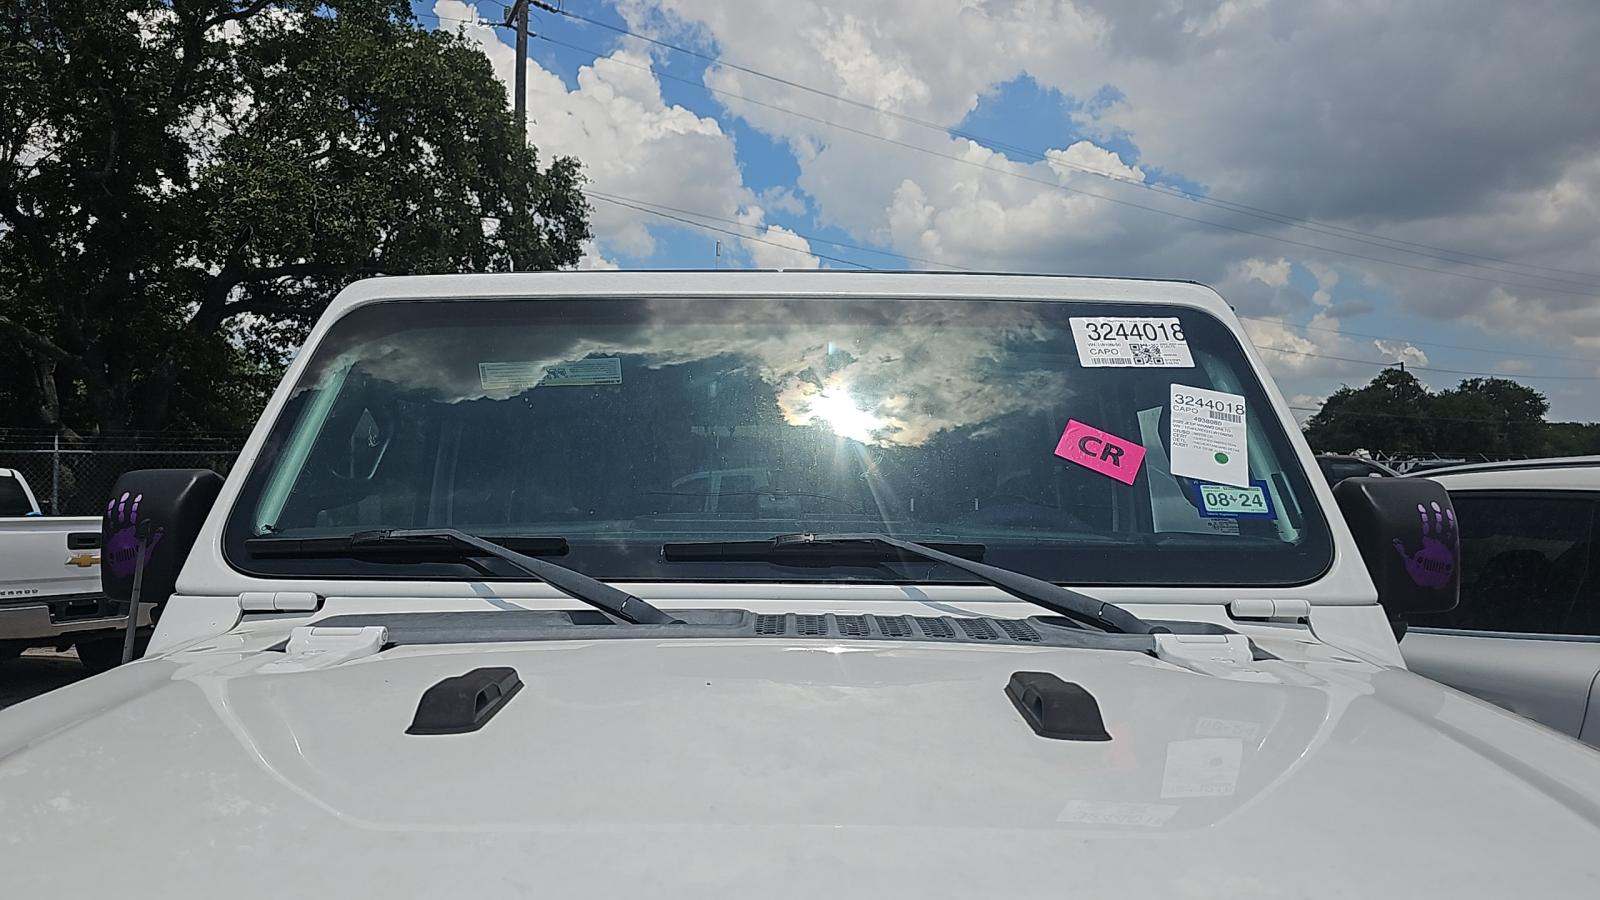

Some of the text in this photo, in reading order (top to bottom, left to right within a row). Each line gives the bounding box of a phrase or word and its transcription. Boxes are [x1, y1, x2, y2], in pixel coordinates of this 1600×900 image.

[1087, 322, 1185, 341] 3244018
[1089, 347, 1119, 356] CAPO
[1173, 405, 1199, 414] CAPO
[1174, 394, 1245, 415] 3244018
[1079, 436, 1124, 467] CR
[1206, 493, 1264, 507] 08 24
